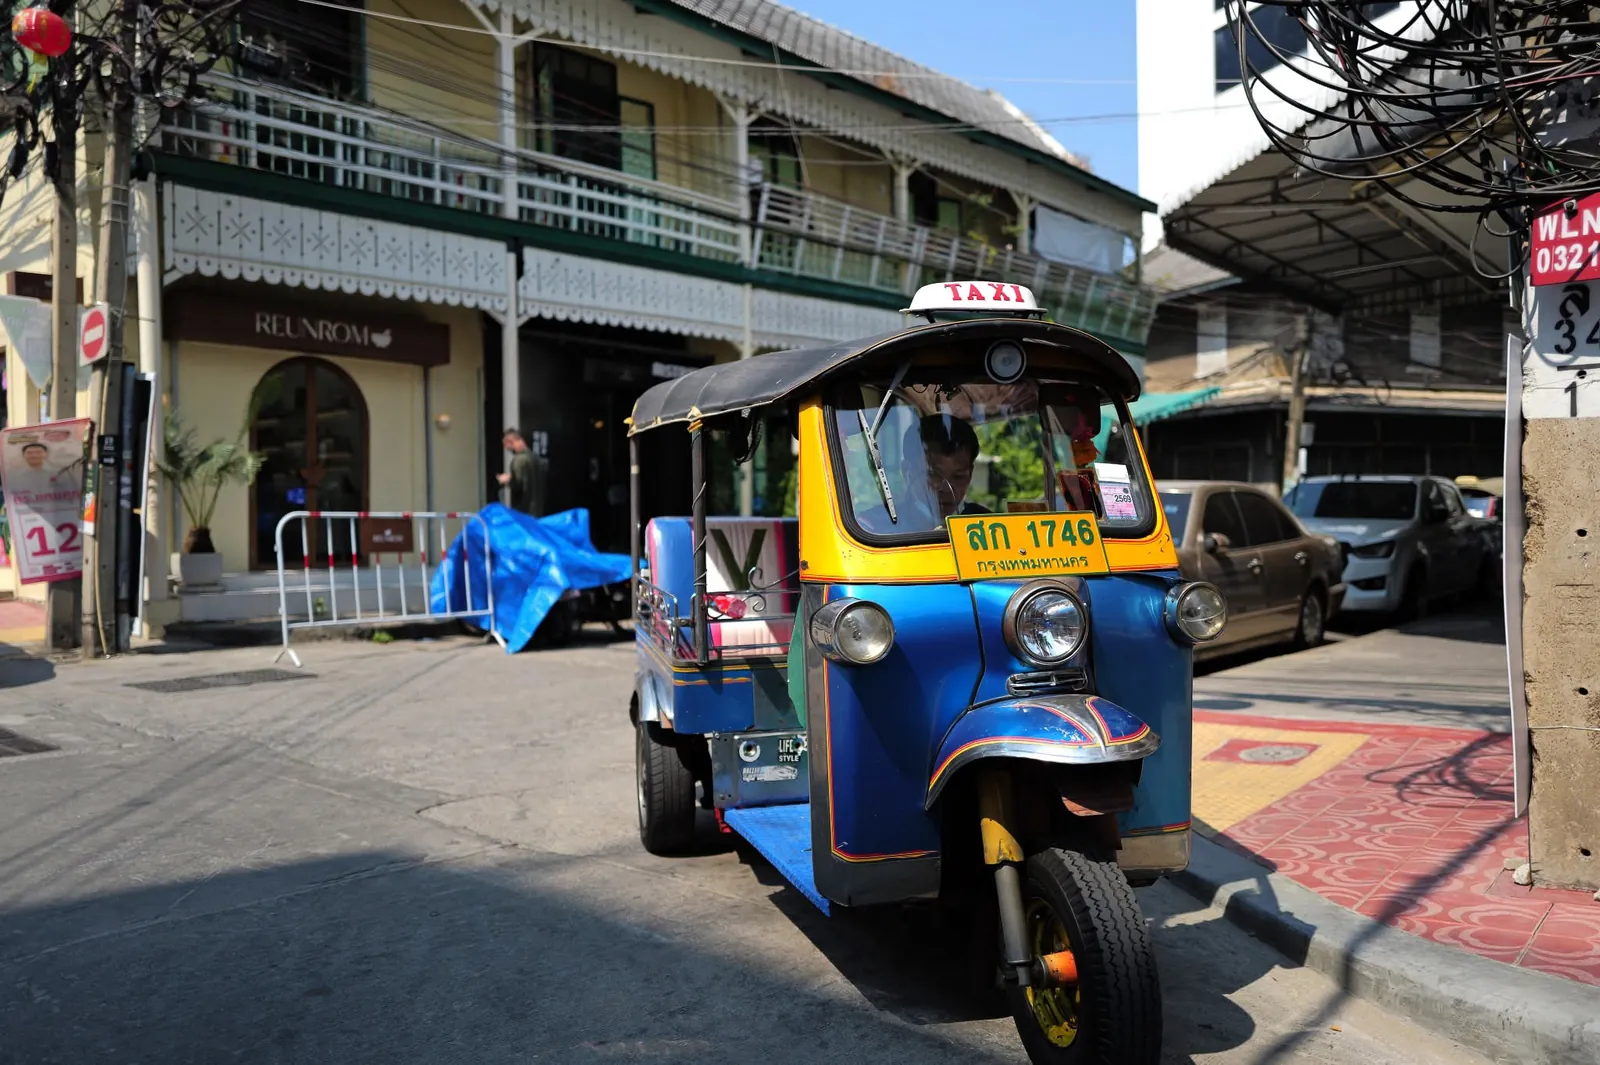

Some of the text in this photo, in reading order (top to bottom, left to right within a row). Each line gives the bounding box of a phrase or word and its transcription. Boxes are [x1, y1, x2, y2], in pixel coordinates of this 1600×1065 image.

[944, 283, 1025, 302] TAXI
[255, 311, 369, 346] REUNROM
[1565, 381, 1577, 417] 1
[1114, 494, 1132, 503] 2569
[26, 522, 82, 557] 12
[966, 519, 1095, 550] สก 1746
[977, 555, 1089, 574] กรุงเทพมหานคร
[779, 754, 799, 762] STYLE
